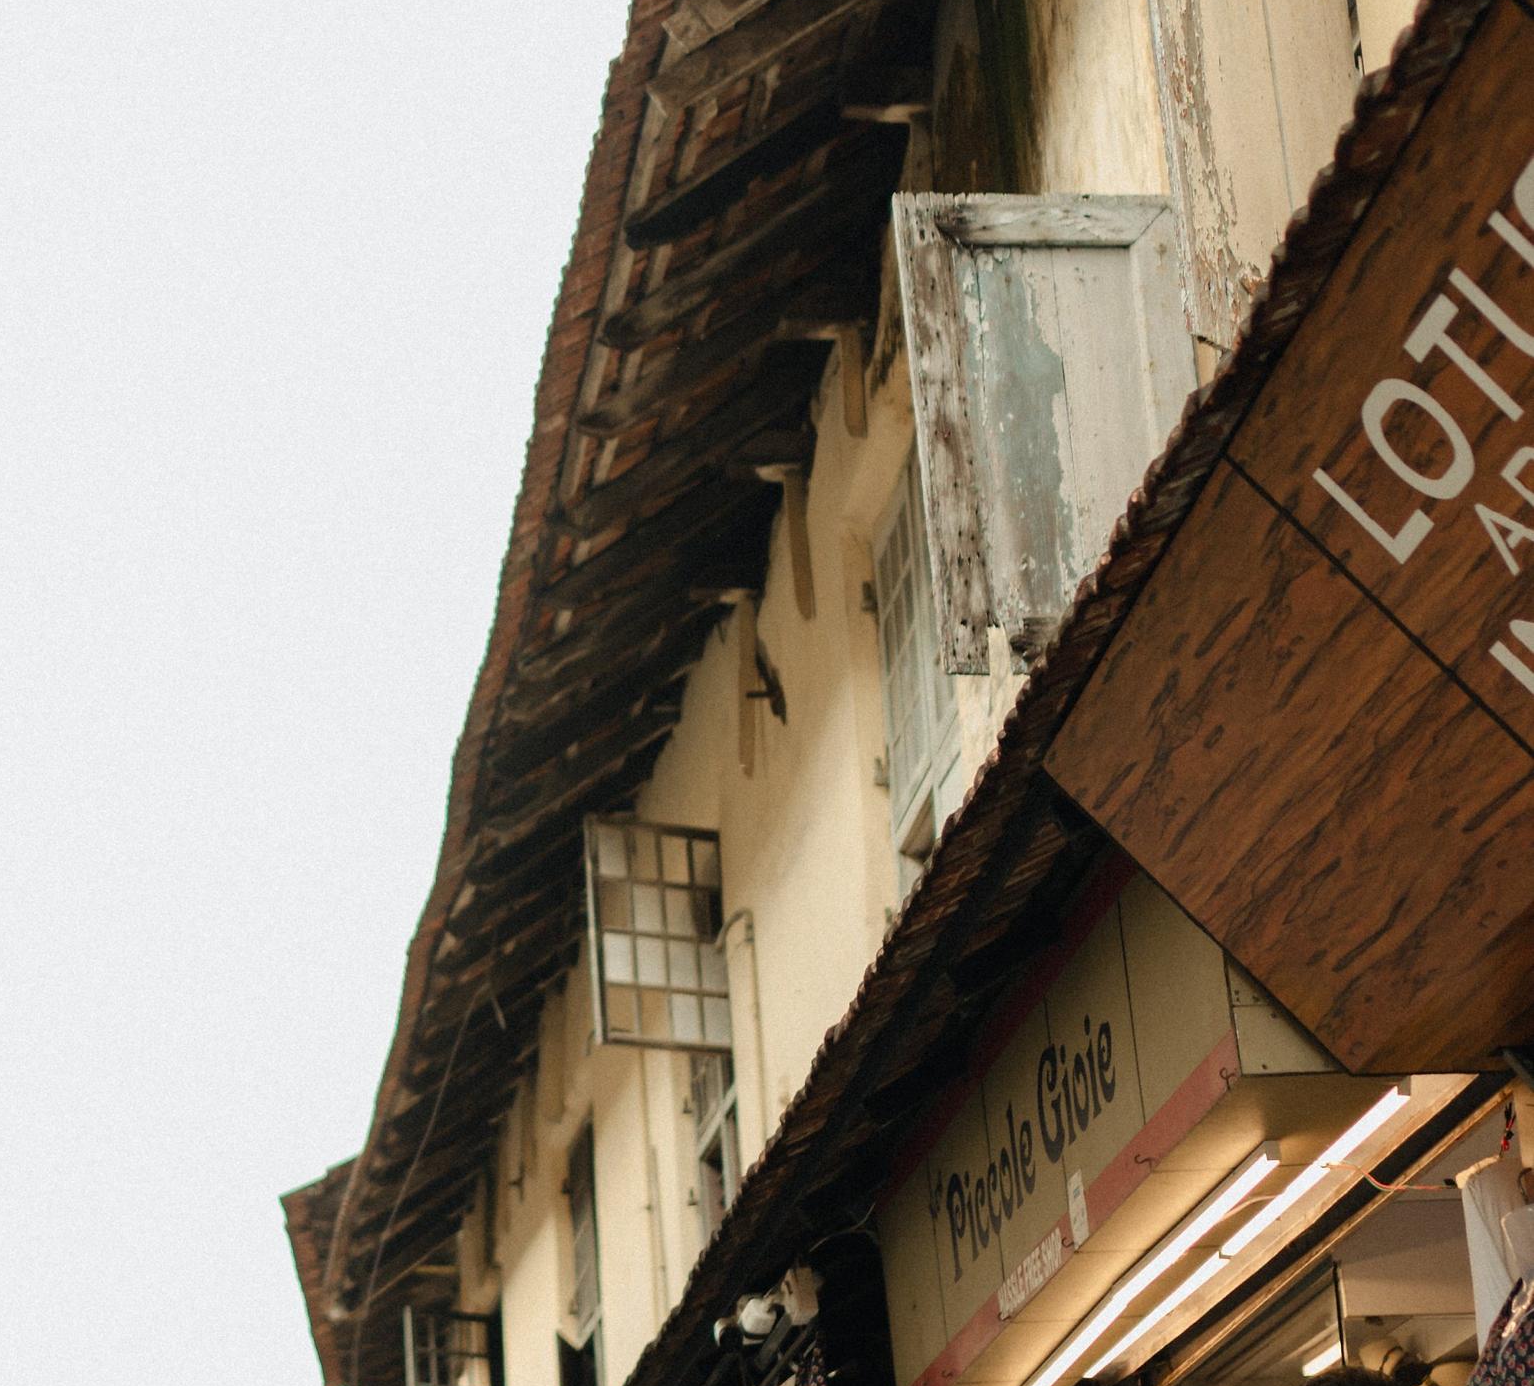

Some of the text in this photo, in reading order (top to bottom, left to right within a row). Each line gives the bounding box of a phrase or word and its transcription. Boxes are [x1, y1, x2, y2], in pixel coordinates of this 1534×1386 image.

[1312, 157, 1534, 565] LOTU
[946, 1015, 1116, 1284] Piccole Gioie
